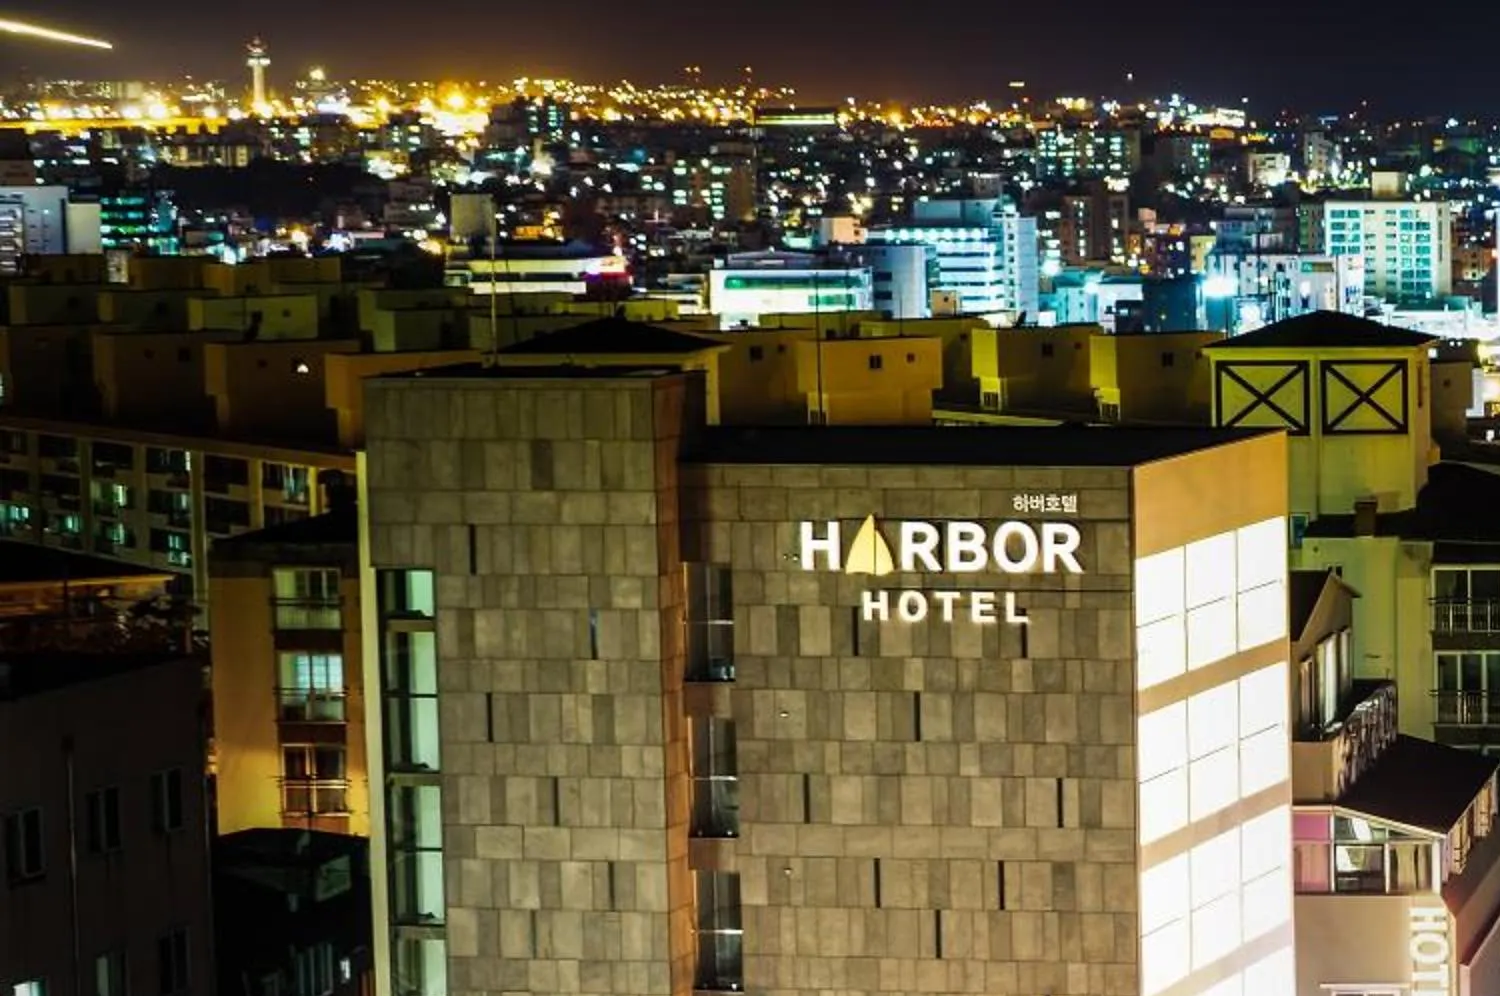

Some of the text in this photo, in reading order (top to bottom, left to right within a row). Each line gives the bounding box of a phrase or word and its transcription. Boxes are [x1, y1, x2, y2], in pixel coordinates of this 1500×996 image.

[1012, 493, 1078, 514] 하버호텔
[800, 514, 1085, 576] HARBOR
[861, 590, 1031, 625] HOTEL
